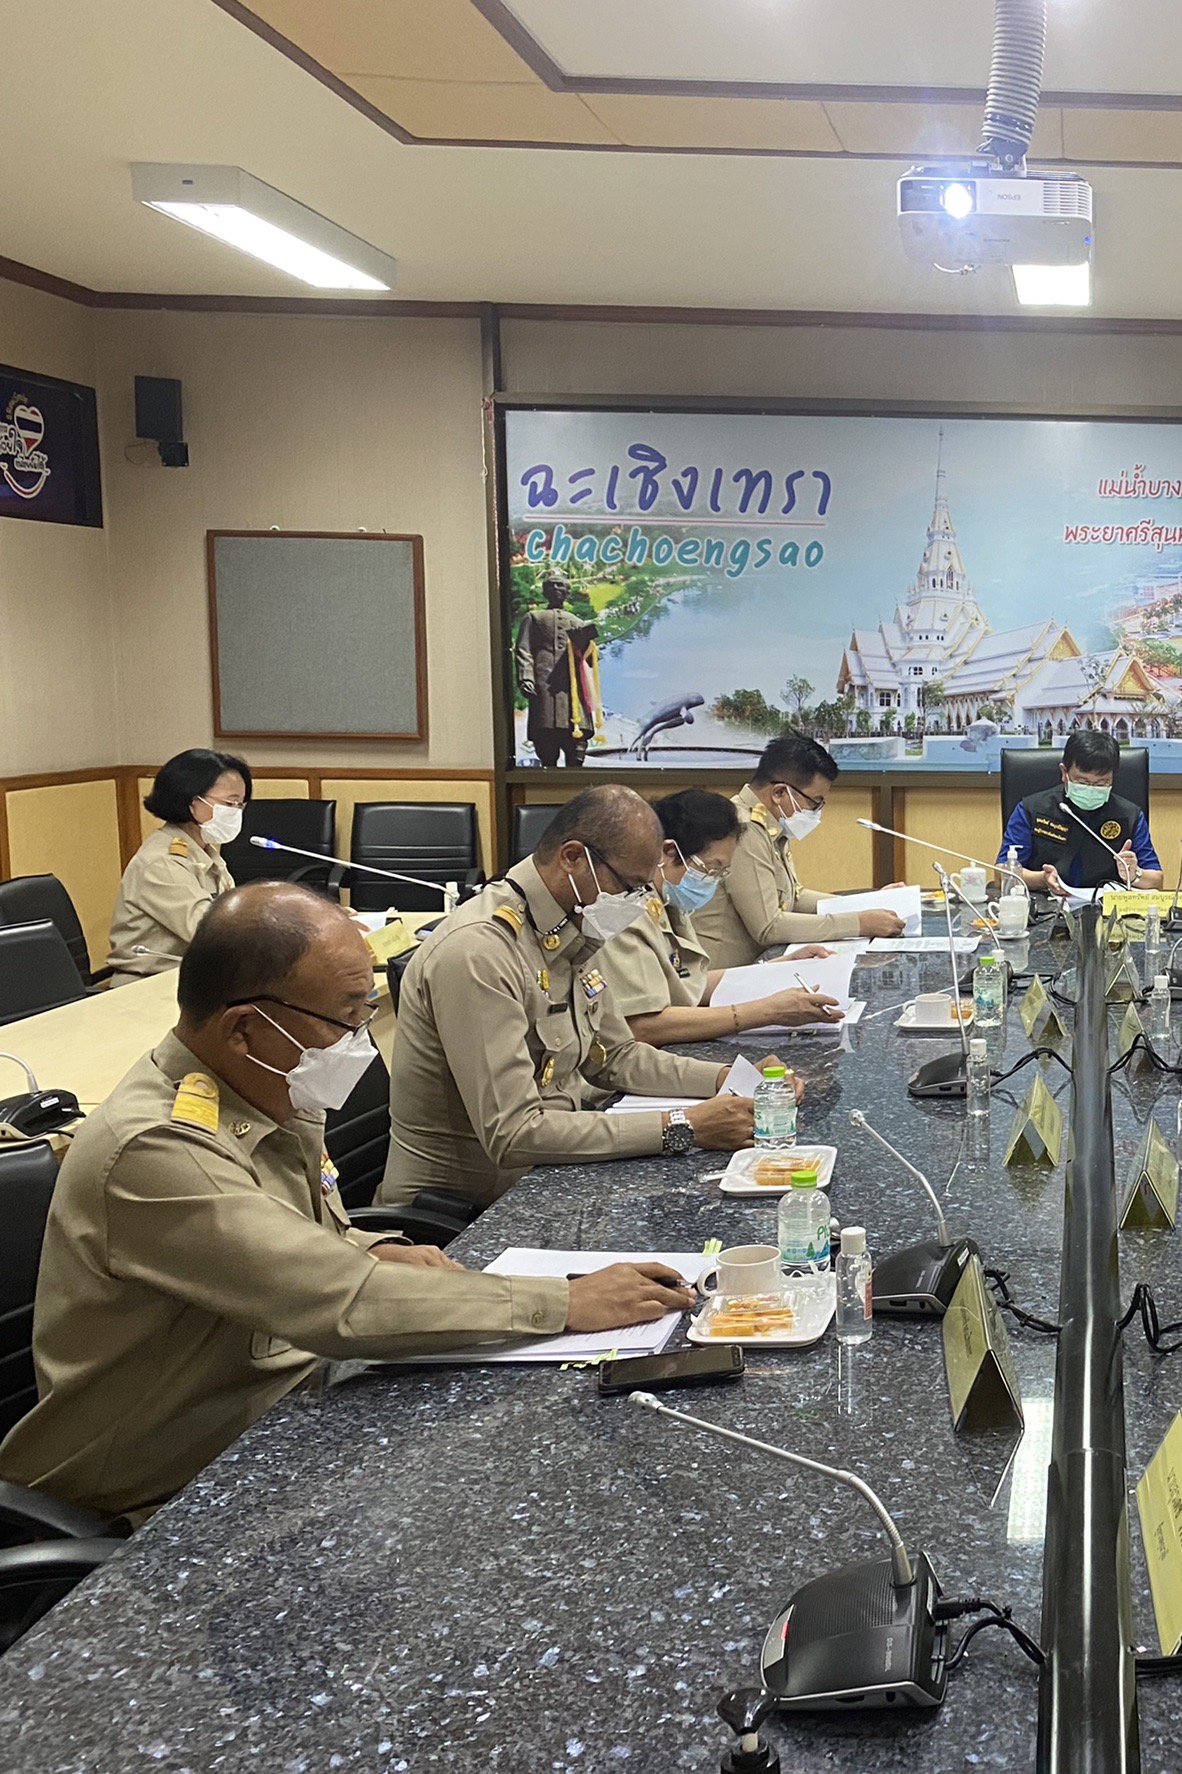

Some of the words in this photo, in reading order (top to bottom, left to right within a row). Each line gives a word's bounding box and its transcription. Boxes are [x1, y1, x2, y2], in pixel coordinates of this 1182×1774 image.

[997, 193, 1021, 201] EPSON
[520, 442, 832, 516] ฉะเชิงเทรา
